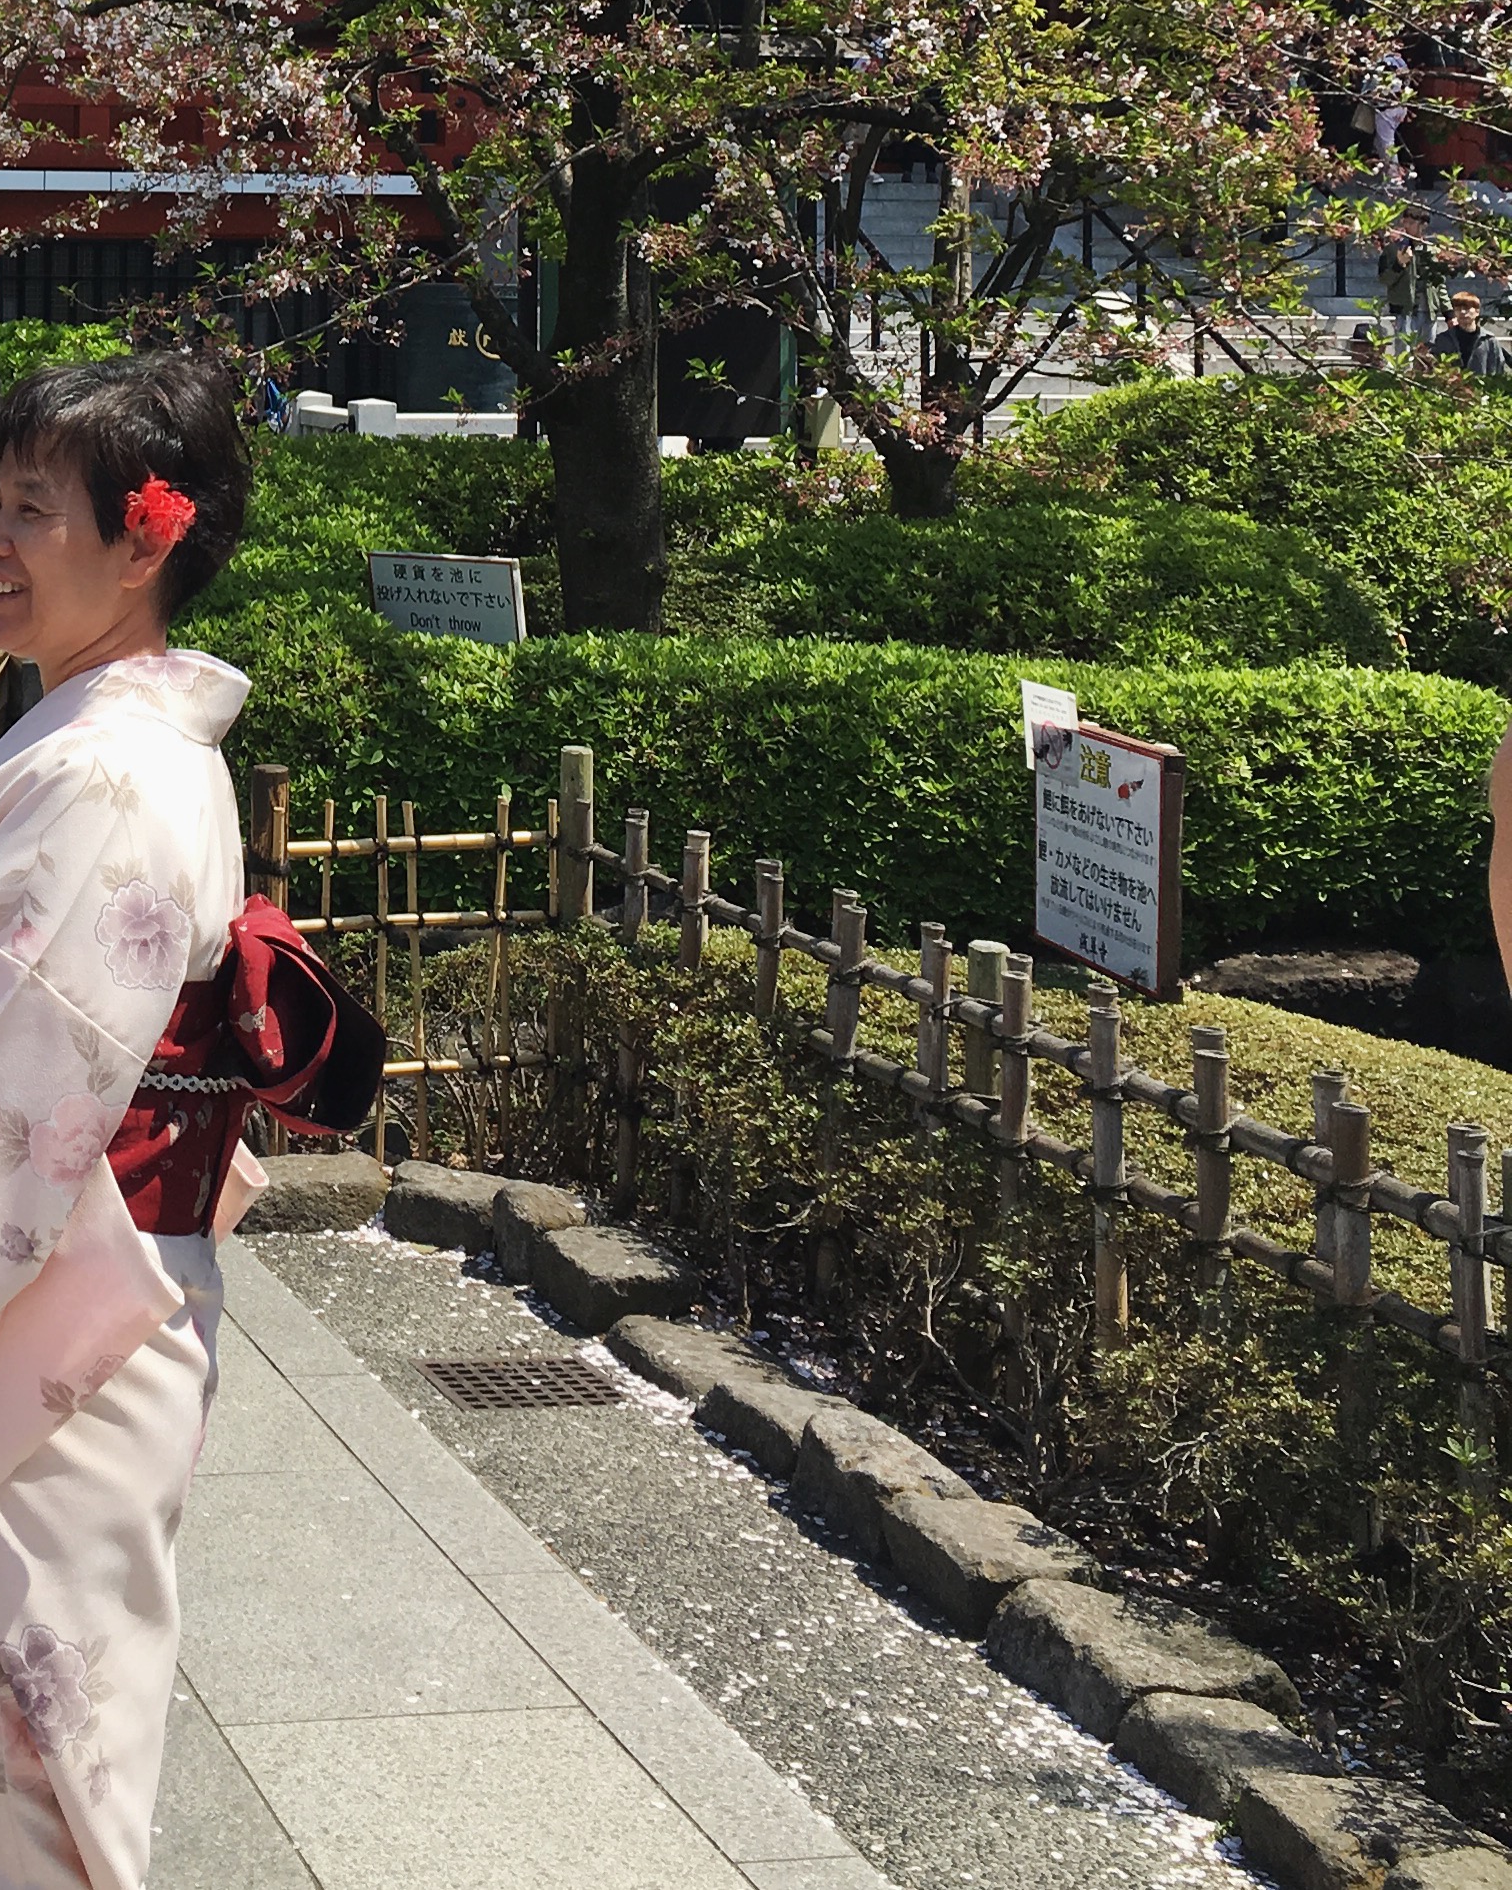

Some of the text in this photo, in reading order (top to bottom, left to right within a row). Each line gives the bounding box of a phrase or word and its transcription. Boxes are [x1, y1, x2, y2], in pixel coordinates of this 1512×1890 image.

[393, 563, 482, 584] 硬貨を池に
[376, 585, 511, 609] 投げ入れないで下さい
[410, 612, 481, 632] Don't throw
[1080, 743, 1111, 789] 注意
